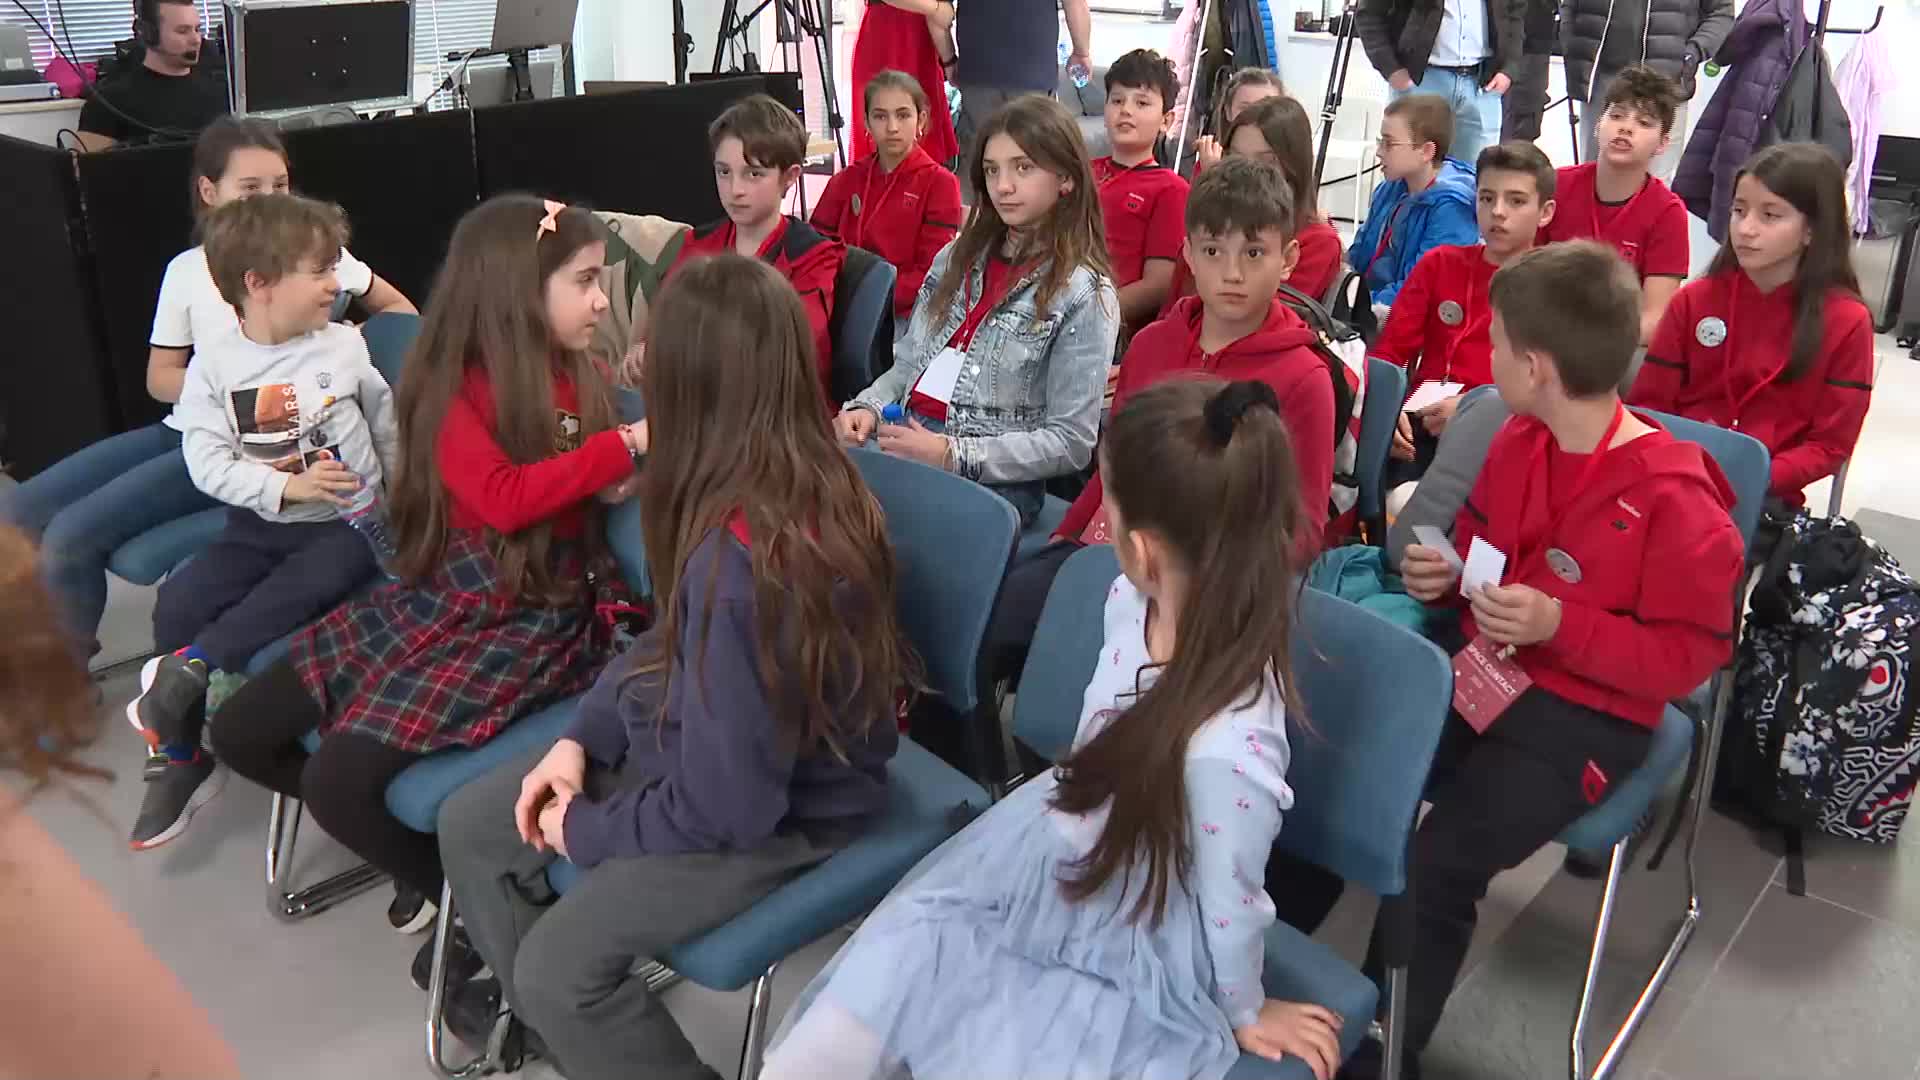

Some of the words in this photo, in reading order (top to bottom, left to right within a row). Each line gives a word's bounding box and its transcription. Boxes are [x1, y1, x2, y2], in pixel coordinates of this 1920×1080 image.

[282, 386, 301, 440] MARS
[1466, 642, 1489, 666] SPACE
[1484, 663, 1518, 697] CONTACT
